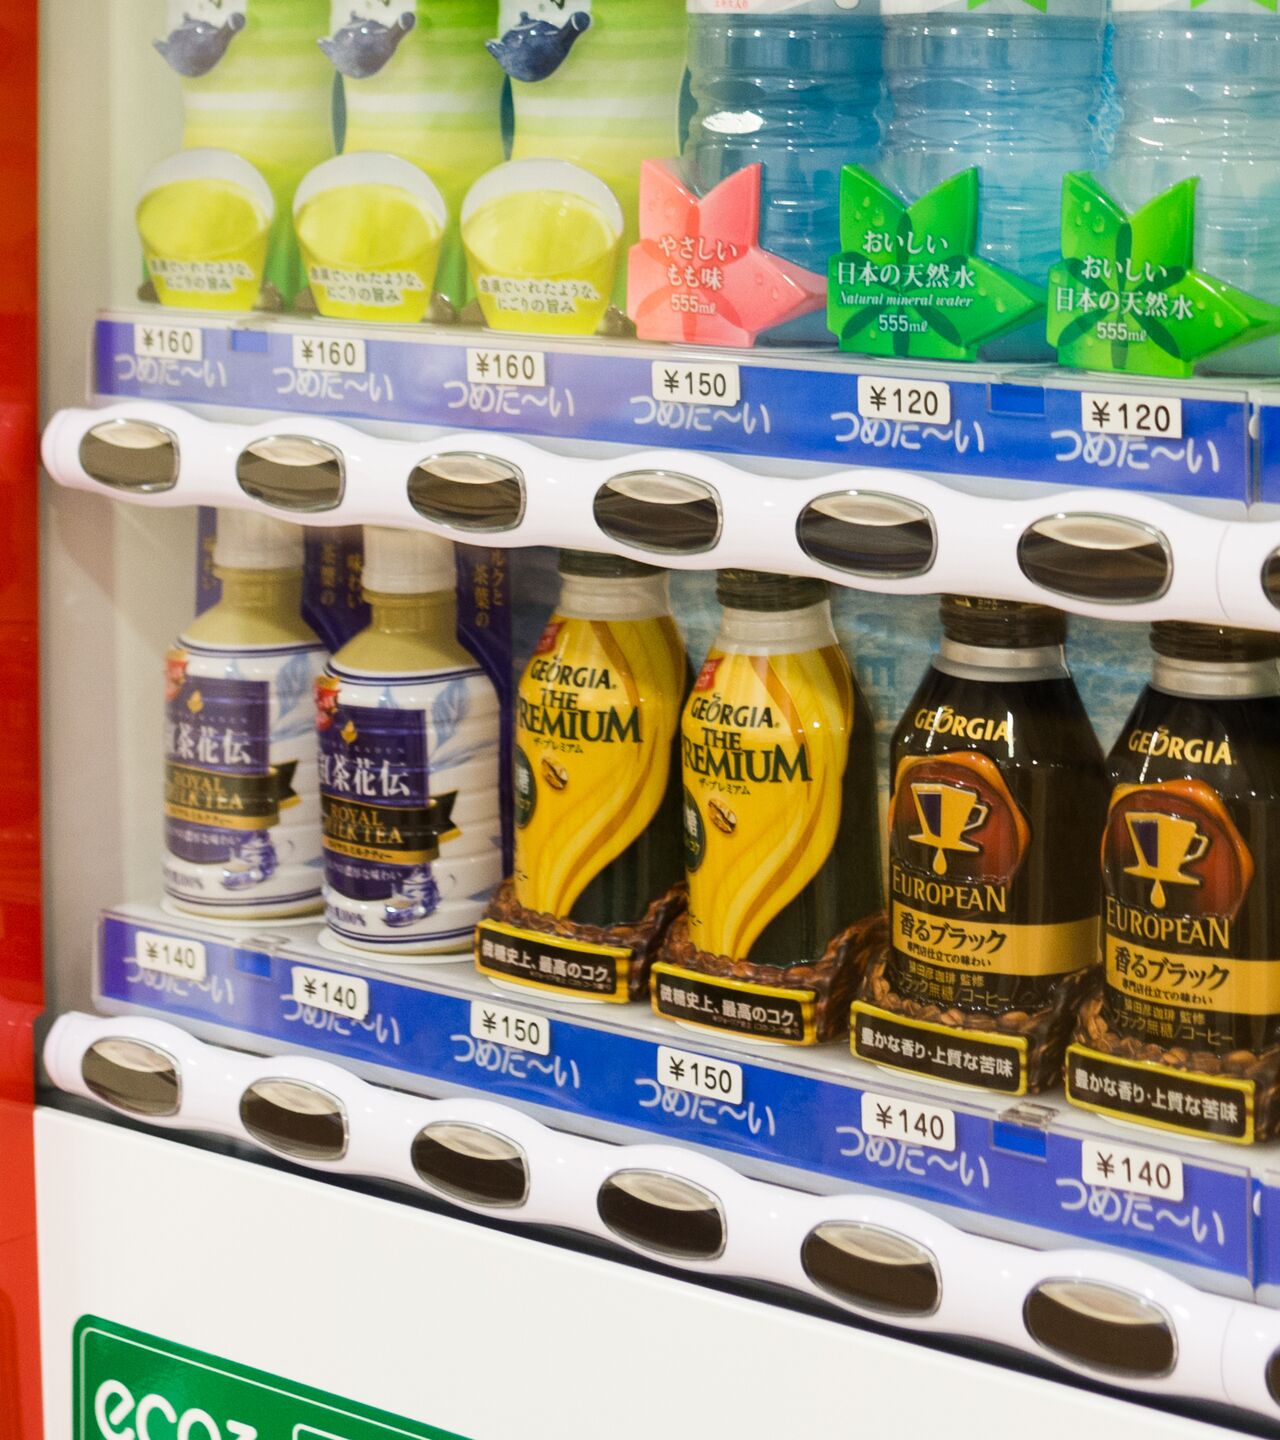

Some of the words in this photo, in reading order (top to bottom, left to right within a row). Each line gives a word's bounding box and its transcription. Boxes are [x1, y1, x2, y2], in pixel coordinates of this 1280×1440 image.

[658, 234, 737, 262] やさしい
[862, 231, 949, 255] おいしい
[666, 265, 723, 291] もも味
[837, 262, 976, 290] 日本の天然水
[1081, 255, 1168, 283] おいしい
[838, 290, 884, 305] Natural
[886, 293, 933, 307] mineral
[936, 295, 974, 308] water
[1056, 287, 1194, 320] 日本の天然水
[144, 328, 194, 355] ¥160
[301, 340, 356, 366] ¥160
[476, 353, 535, 380] ¥160
[663, 369, 727, 398] ¥150
[868, 386, 939, 418] ¥120
[1091, 401, 1171, 434] ¥120
[540, 687, 578, 713] THE
[519, 703, 643, 744] REMIUM
[701, 726, 741, 751] THE
[364, 825, 405, 845] TEA
[892, 865, 1008, 914] EUROPEAN
[898, 910, 1008, 955] 香るブラック
[1105, 893, 1232, 951] EUROPEAN
[145, 940, 196, 969] ¥140
[1112, 944, 1232, 991] 香るブラック
[303, 980, 358, 1011] ¥140
[483, 1012, 540, 1045] ¥150
[668, 1062, 734, 1094] ¥150
[874, 1104, 946, 1141] ¥140
[1095, 1150, 1172, 1190] ¥140
[94, 1378, 258, 1440] eco
